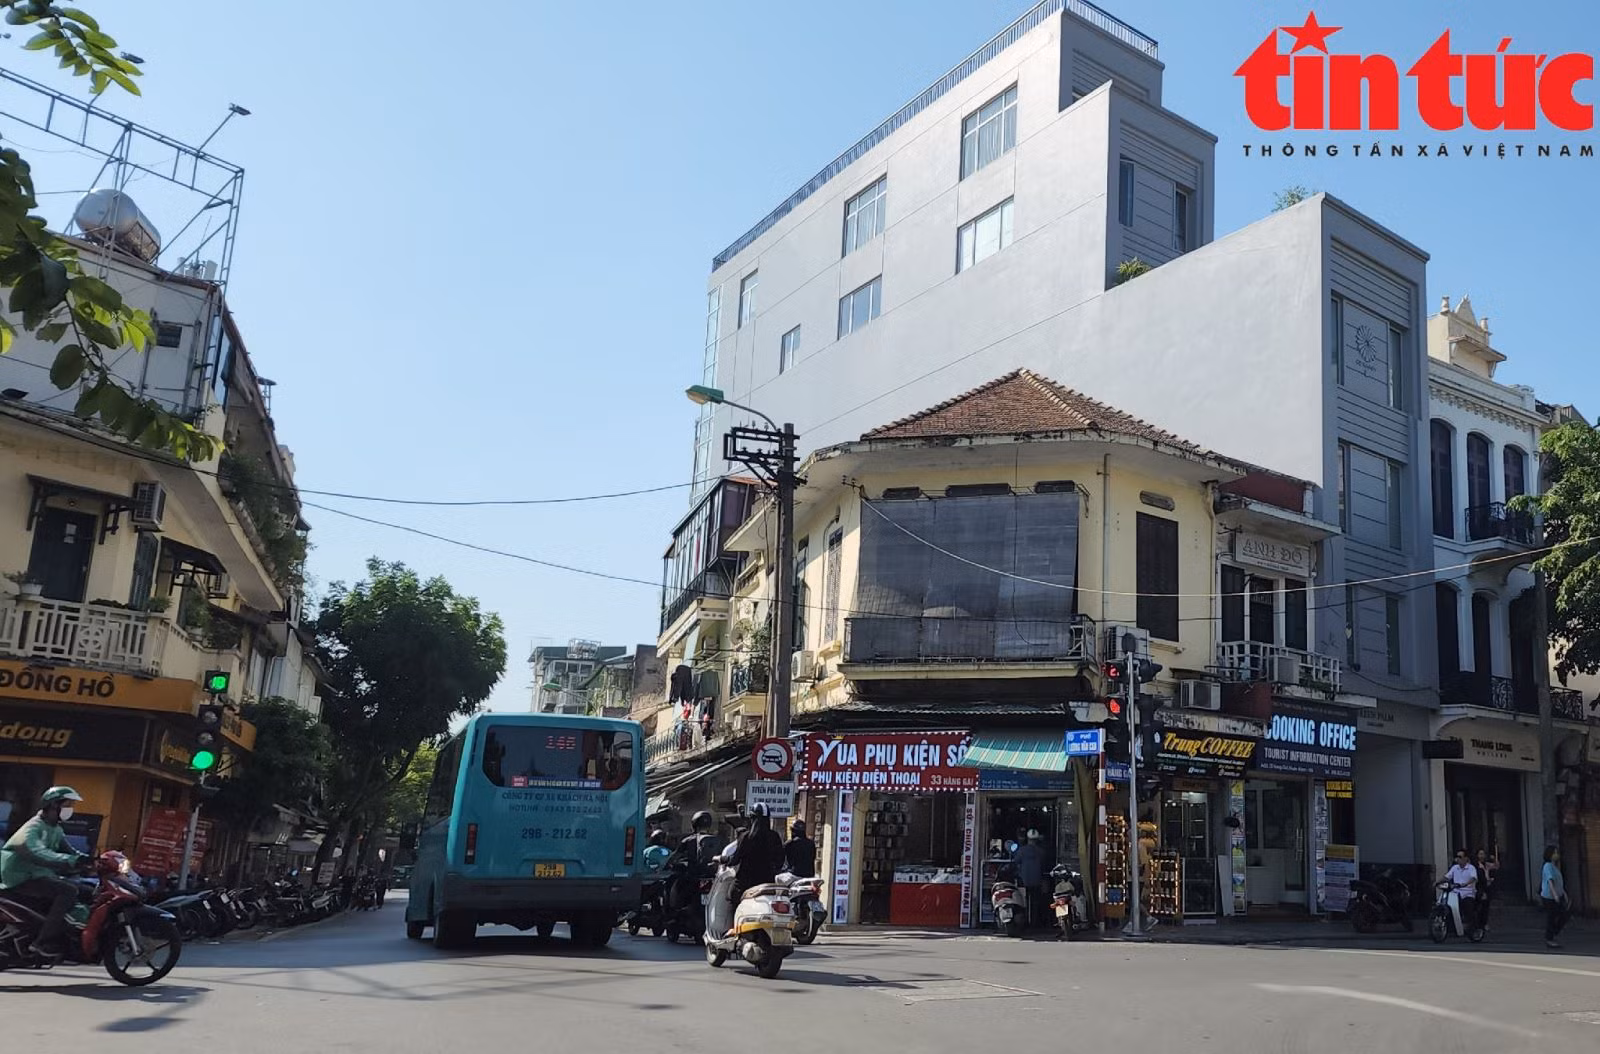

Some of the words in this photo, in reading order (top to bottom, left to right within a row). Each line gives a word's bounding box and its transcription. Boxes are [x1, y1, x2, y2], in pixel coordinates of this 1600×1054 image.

[77, 672, 115, 698] HỒ
[1319, 721, 1357, 751] OFFICE
[864, 743, 897, 771] PHỤ
[903, 739, 941, 771] KIỆN
[1264, 747, 1289, 761] TOURIST
[1289, 750, 1329, 766] INFORMATION
[1329, 755, 1352, 768] CENTER
[930, 775, 942, 786] 33
[522, 828, 542, 840] 29B
